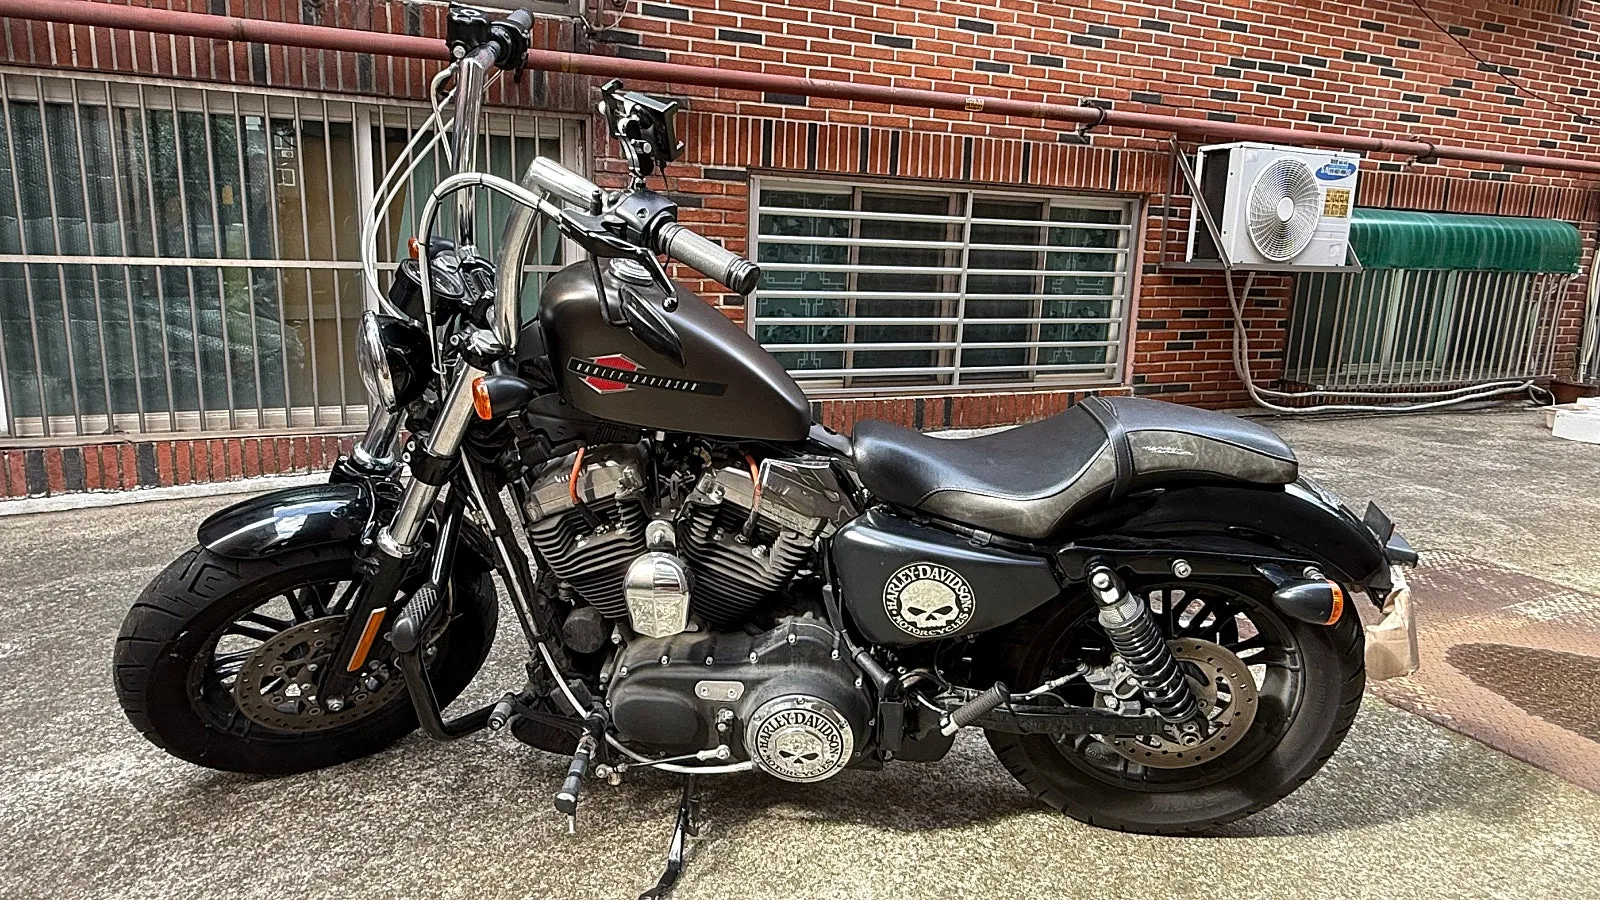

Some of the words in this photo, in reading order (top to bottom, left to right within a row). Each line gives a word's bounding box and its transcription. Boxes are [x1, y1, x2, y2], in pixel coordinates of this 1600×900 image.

[576, 363, 699, 391] HARLEY-DAVIDSON
[886, 565, 972, 610] HARLEY-DAVIDSON
[893, 612, 969, 636] MOTORCYCLES
[760, 712, 840, 756] HARLEY-DAVIDSON
[764, 755, 835, 777] MOTORCYCLES
